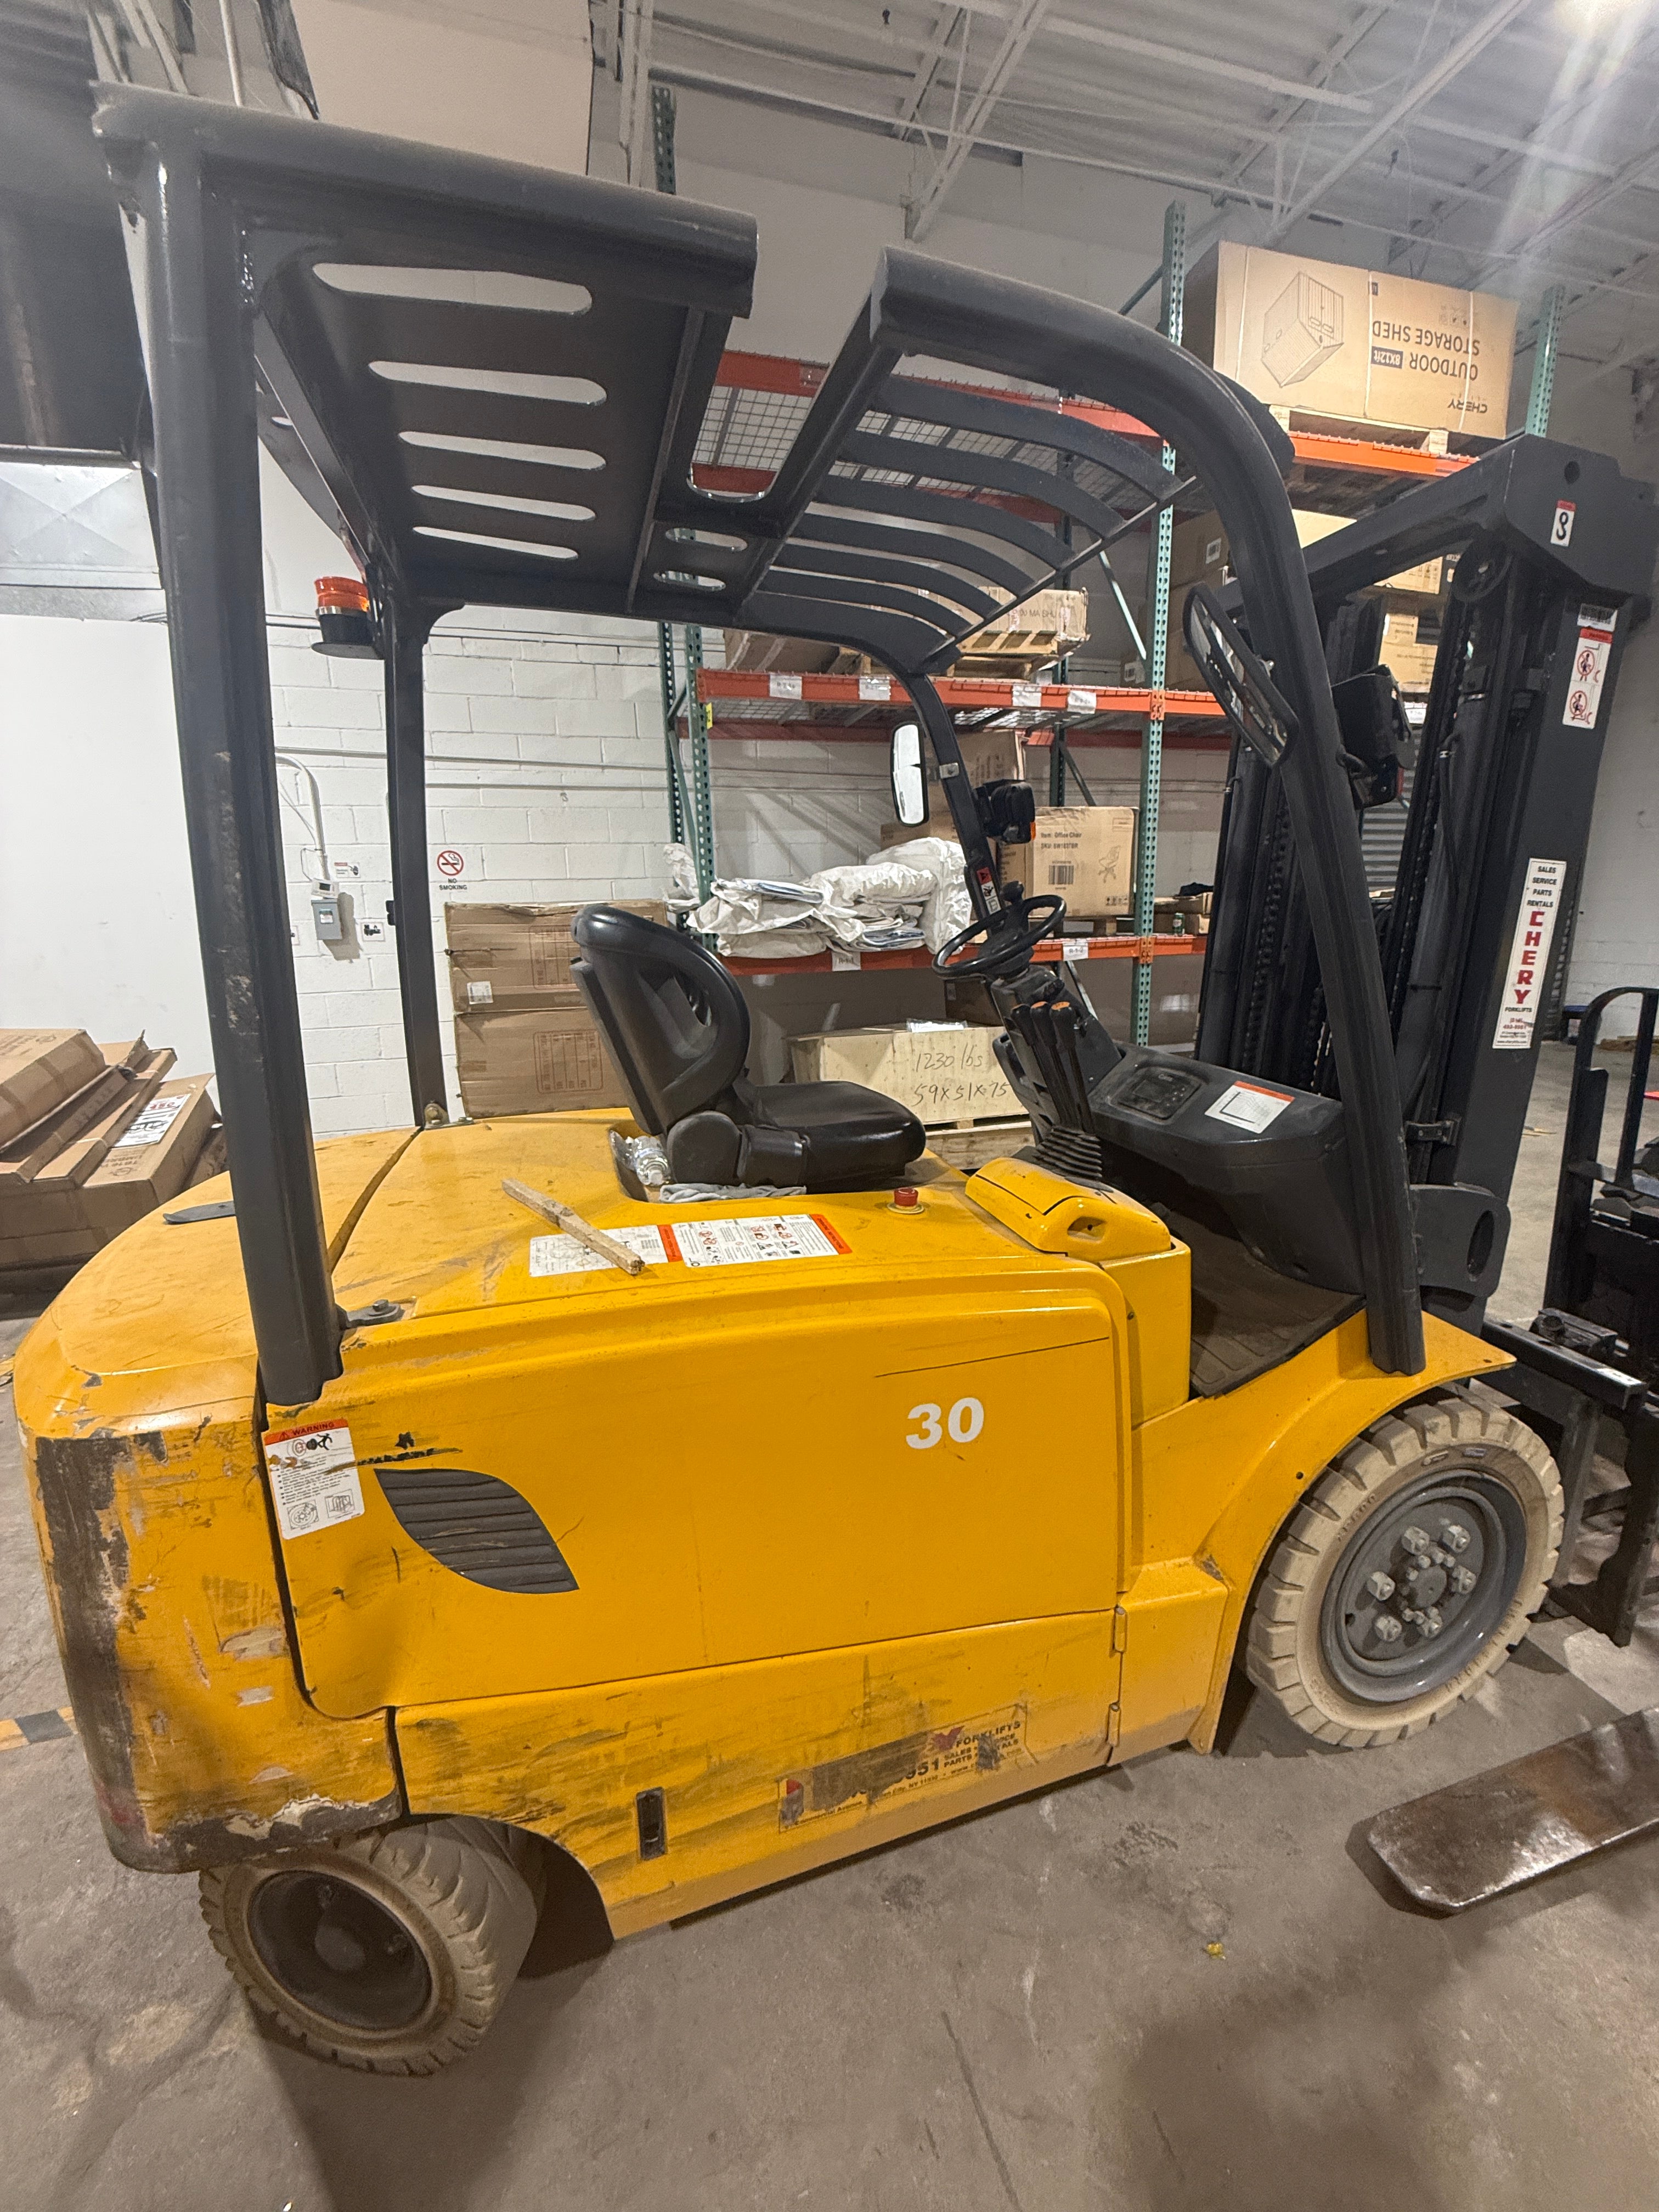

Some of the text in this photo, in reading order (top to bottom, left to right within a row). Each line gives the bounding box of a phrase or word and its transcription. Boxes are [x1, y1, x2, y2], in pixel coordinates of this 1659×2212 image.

[1373, 320, 1480, 356] STORAGE SHED
[1409, 352, 1478, 381] OUTDOOR
[1447, 398, 1488, 414] CHERY
[1532, 877, 1557, 885] SERVICE
[1527, 900, 1554, 908] RENTALS
[1514, 911, 1545, 1005] CHERY
[916, 1053, 955, 1073] 1230
[292, 1421, 335, 1436] WARNING
[906, 1397, 984, 1449] 30
[944, 1754, 972, 1768] PARTS
